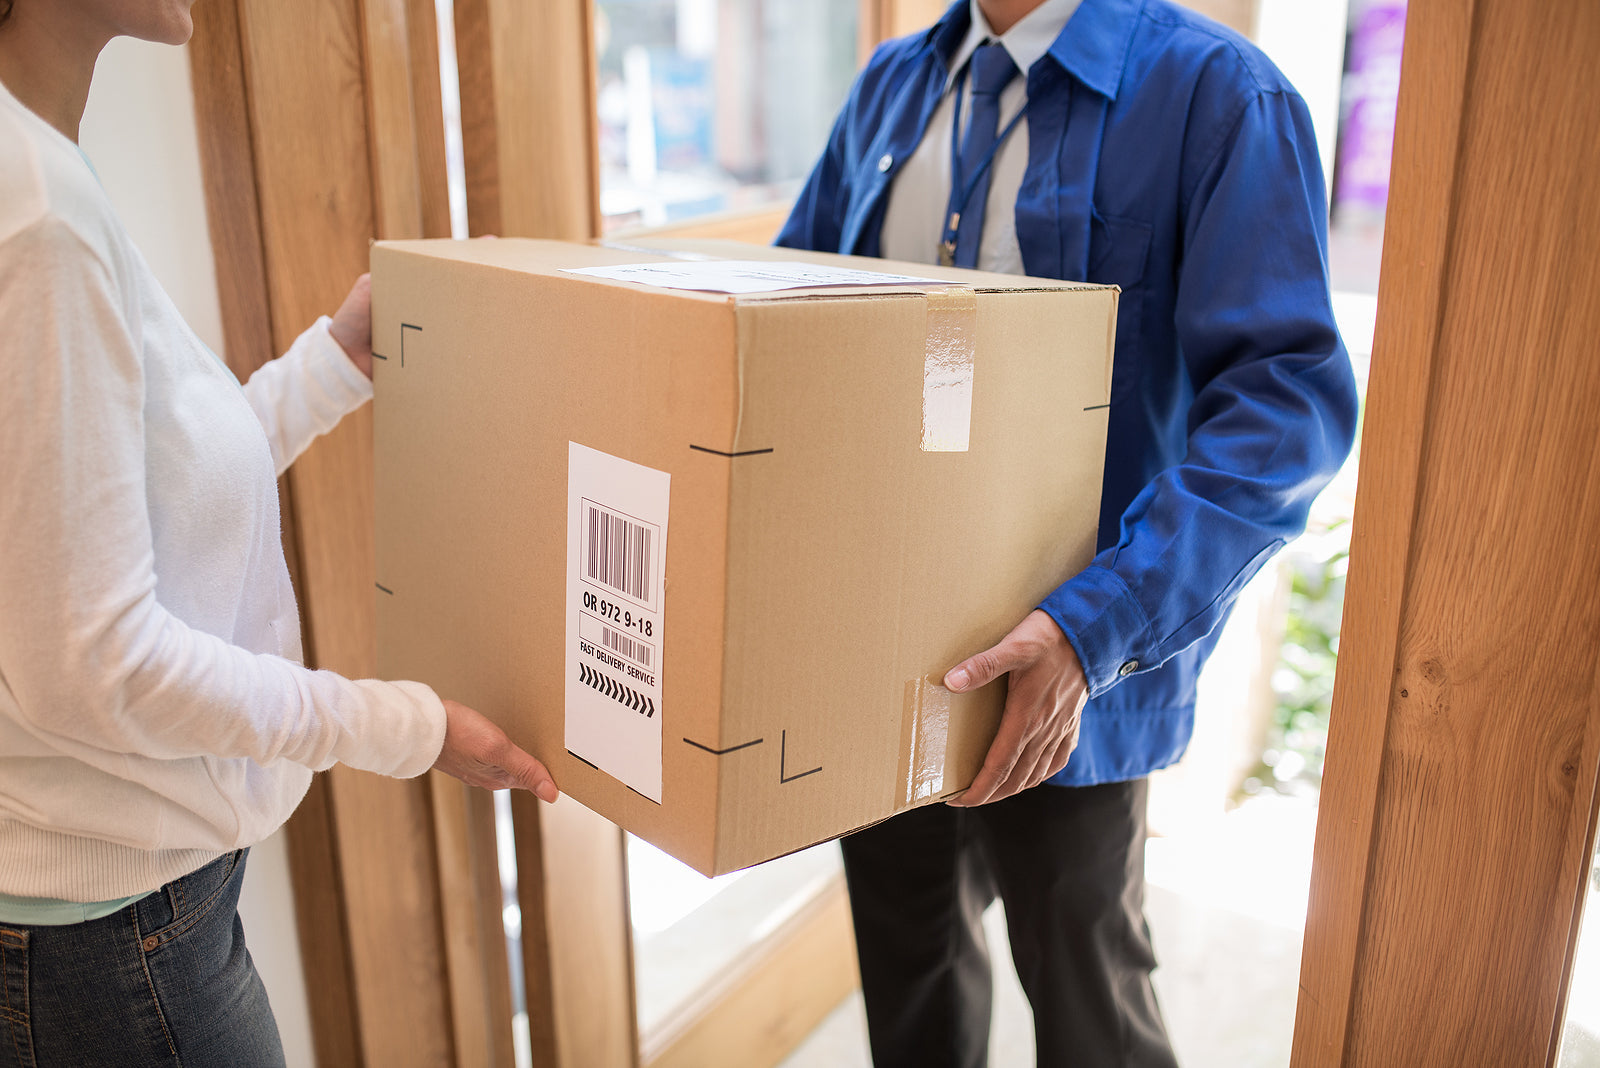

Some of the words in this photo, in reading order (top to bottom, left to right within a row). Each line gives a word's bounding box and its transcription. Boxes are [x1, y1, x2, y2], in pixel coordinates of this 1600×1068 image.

[583, 591, 597, 612] OR
[600, 599, 621, 623] 972
[624, 611, 653, 637] 9-18
[580, 641, 595, 657] FAST
[596, 649, 626, 673] DELIVERY
[627, 665, 655, 687] SERVICE
